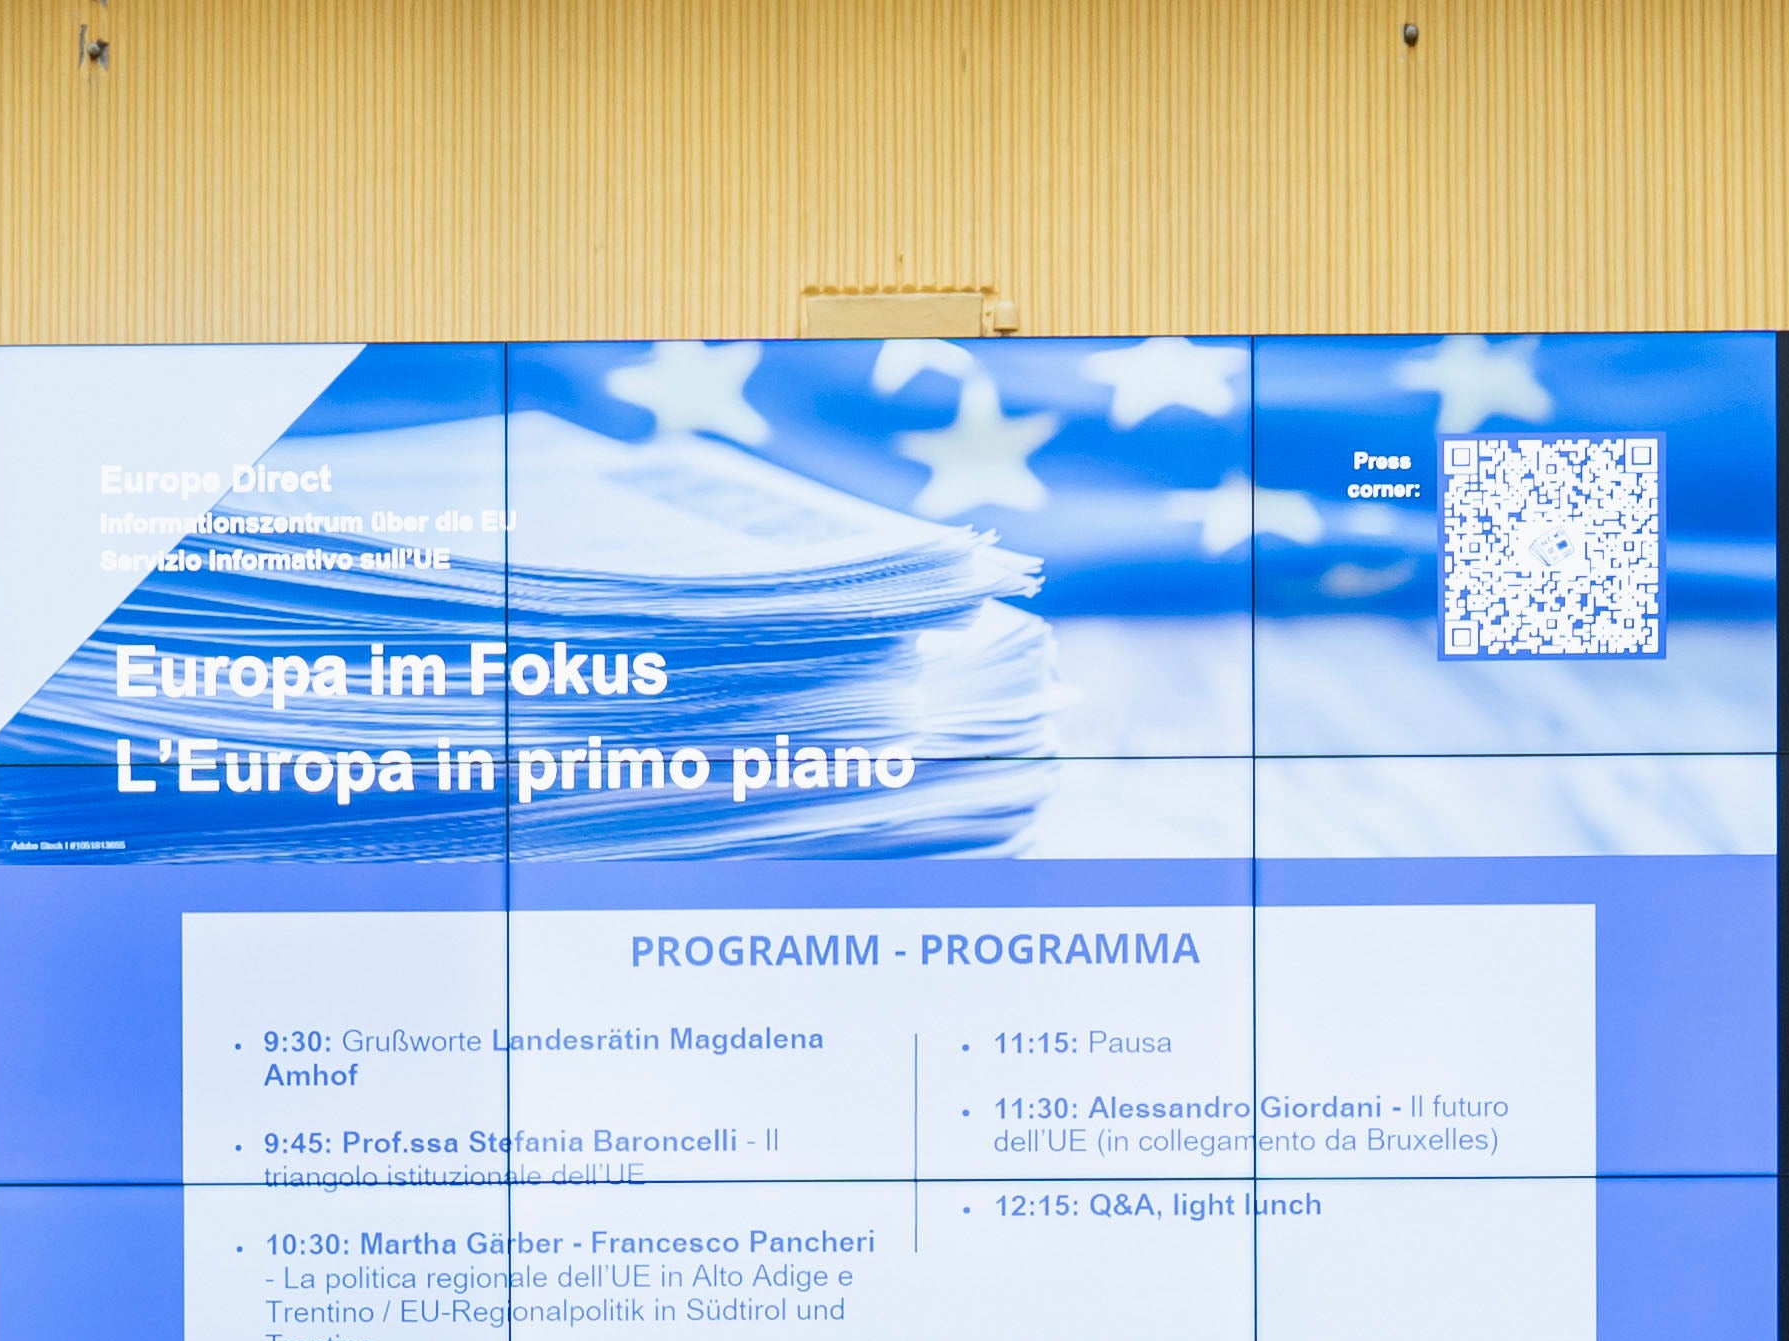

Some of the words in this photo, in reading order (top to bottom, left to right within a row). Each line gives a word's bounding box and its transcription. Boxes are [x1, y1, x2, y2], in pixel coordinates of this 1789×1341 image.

[1354, 451, 1412, 471] Press
[101, 465, 221, 499] Europe
[232, 464, 332, 493] Direct
[1348, 480, 1421, 500] corner:
[101, 512, 363, 534] Informationszentrum
[371, 510, 429, 532] über
[435, 510, 475, 532] die
[481, 510, 517, 531] EU
[101, 549, 202, 572] Servizio
[209, 548, 354, 571] informativo
[360, 547, 450, 570] sull’UE
[116, 645, 348, 710] Europa
[372, 643, 446, 695] im
[470, 642, 667, 696] Fokus
[116, 740, 413, 805] L’Europa
[438, 738, 494, 792] in
[519, 735, 709, 803] primo
[732, 735, 915, 803] piano
[632, 935, 880, 968] PROGRAMM
[920, 933, 1201, 965] PROGRAMMA
[264, 1031, 332, 1053] 9:30:
[342, 1030, 482, 1053] Grußworte
[492, 1028, 659, 1052] Landesrätin
[670, 1027, 824, 1056] Magdalena
[995, 1033, 1078, 1054] 11:15:
[1089, 1032, 1172, 1054] Pausa
[264, 1064, 359, 1087] Amhof
[995, 1098, 1078, 1119] 11:30:
[1088, 1097, 1250, 1119] Alessandro
[1260, 1096, 1382, 1118] Giordani
[1432, 1096, 1509, 1118] futuro
[264, 1132, 332, 1155] 9:45:
[342, 1132, 458, 1155] Prof.ssa
[469, 1130, 583, 1154] Stefania
[594, 1130, 738, 1153] Baroncelli
[994, 1129, 1087, 1153] dell’UE
[1097, 1129, 1129, 1158] (in
[1138, 1129, 1315, 1158] collegamento
[1325, 1129, 1357, 1151] da
[1367, 1128, 1498, 1157] Bruxelles)
[265, 1165, 378, 1193] triangolo
[388, 1163, 541, 1185] istituzionale
[996, 1196, 1079, 1216] 12:15:
[1089, 1195, 1163, 1221] Q&A,
[1173, 1194, 1235, 1221] light
[1245, 1193, 1322, 1216] lunch
[266, 1234, 350, 1256] 10:30:
[360, 1233, 456, 1256] Martha
[466, 1232, 563, 1254] Gärber
[591, 1231, 739, 1254] Francesco
[749, 1231, 875, 1253] Pancheri
[284, 1268, 315, 1289] La
[325, 1267, 416, 1295] politica
[427, 1265, 547, 1295] regionale
[557, 1265, 650, 1288] dell’UE
[661, 1265, 682, 1287] in
[692, 1265, 743, 1287] Alto
[752, 1265, 828, 1293] Adige
[838, 1271, 853, 1287] e
[266, 1302, 374, 1324] Trentino
[400, 1299, 644, 1328] EU-Regionalpolitik
[655, 1299, 675, 1321] in
[686, 1299, 787, 1322] Südtirol
[796, 1298, 845, 1321] und
